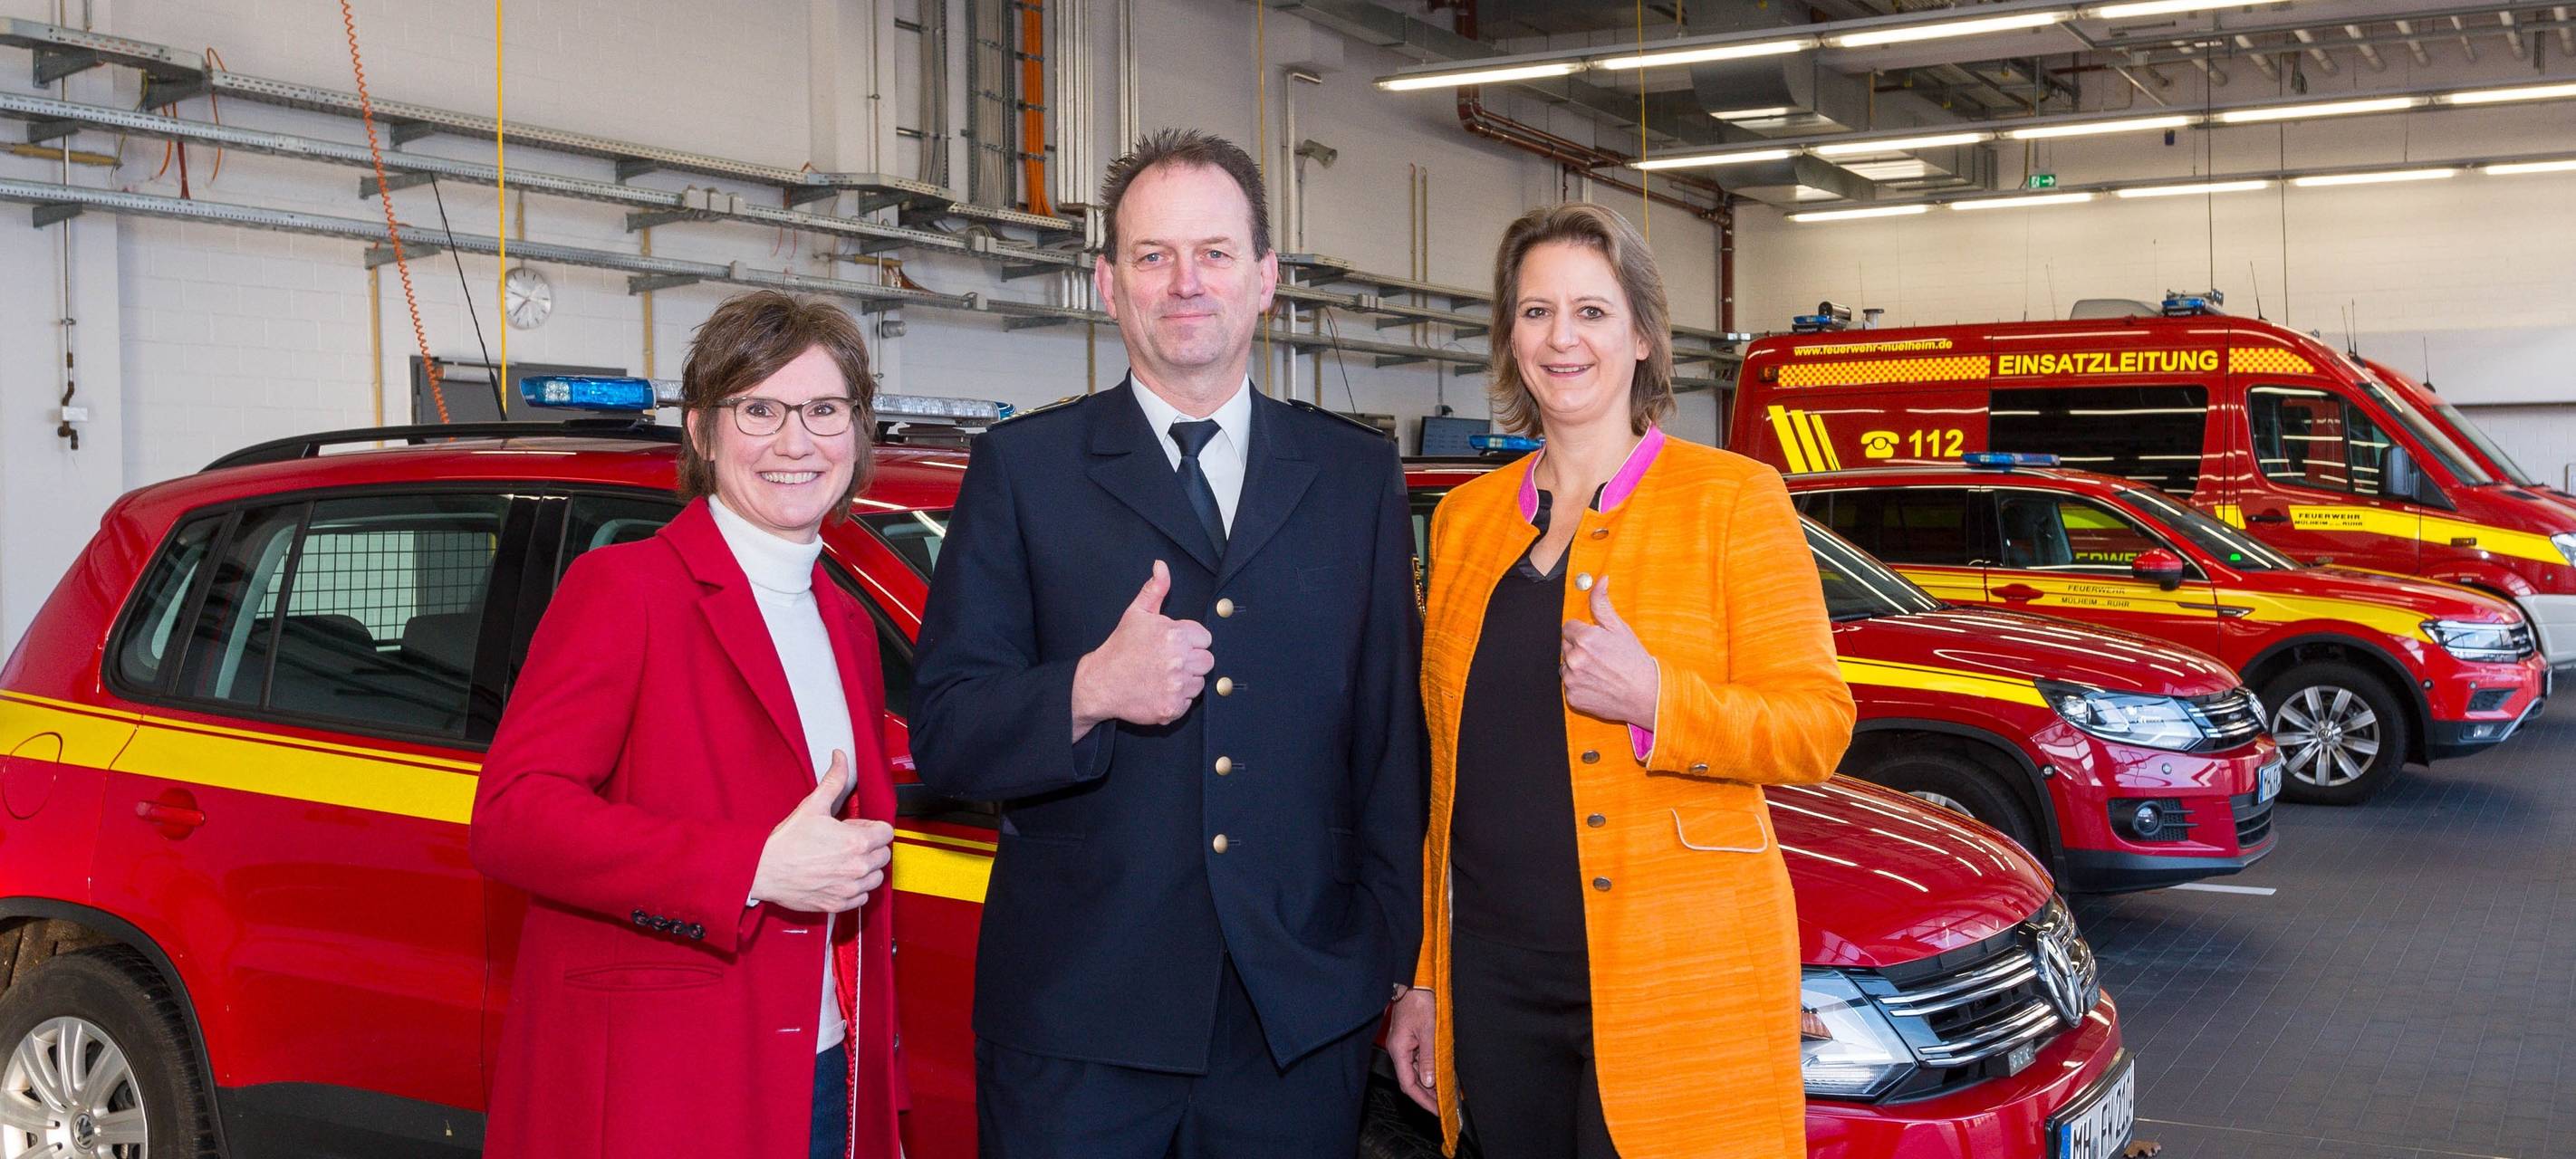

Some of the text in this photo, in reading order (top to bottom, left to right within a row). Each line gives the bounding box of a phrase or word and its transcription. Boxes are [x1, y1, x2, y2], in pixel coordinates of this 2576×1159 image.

[1793, 340, 1953, 356] www.feuerwehr-muelheim.de
[1998, 350, 2219, 375] EINSATZLEITUNG
[1908, 429, 1964, 457] 112
[2067, 584, 2126, 595] FEUERWEHR
[2072, 1117, 2092, 1159] MH
